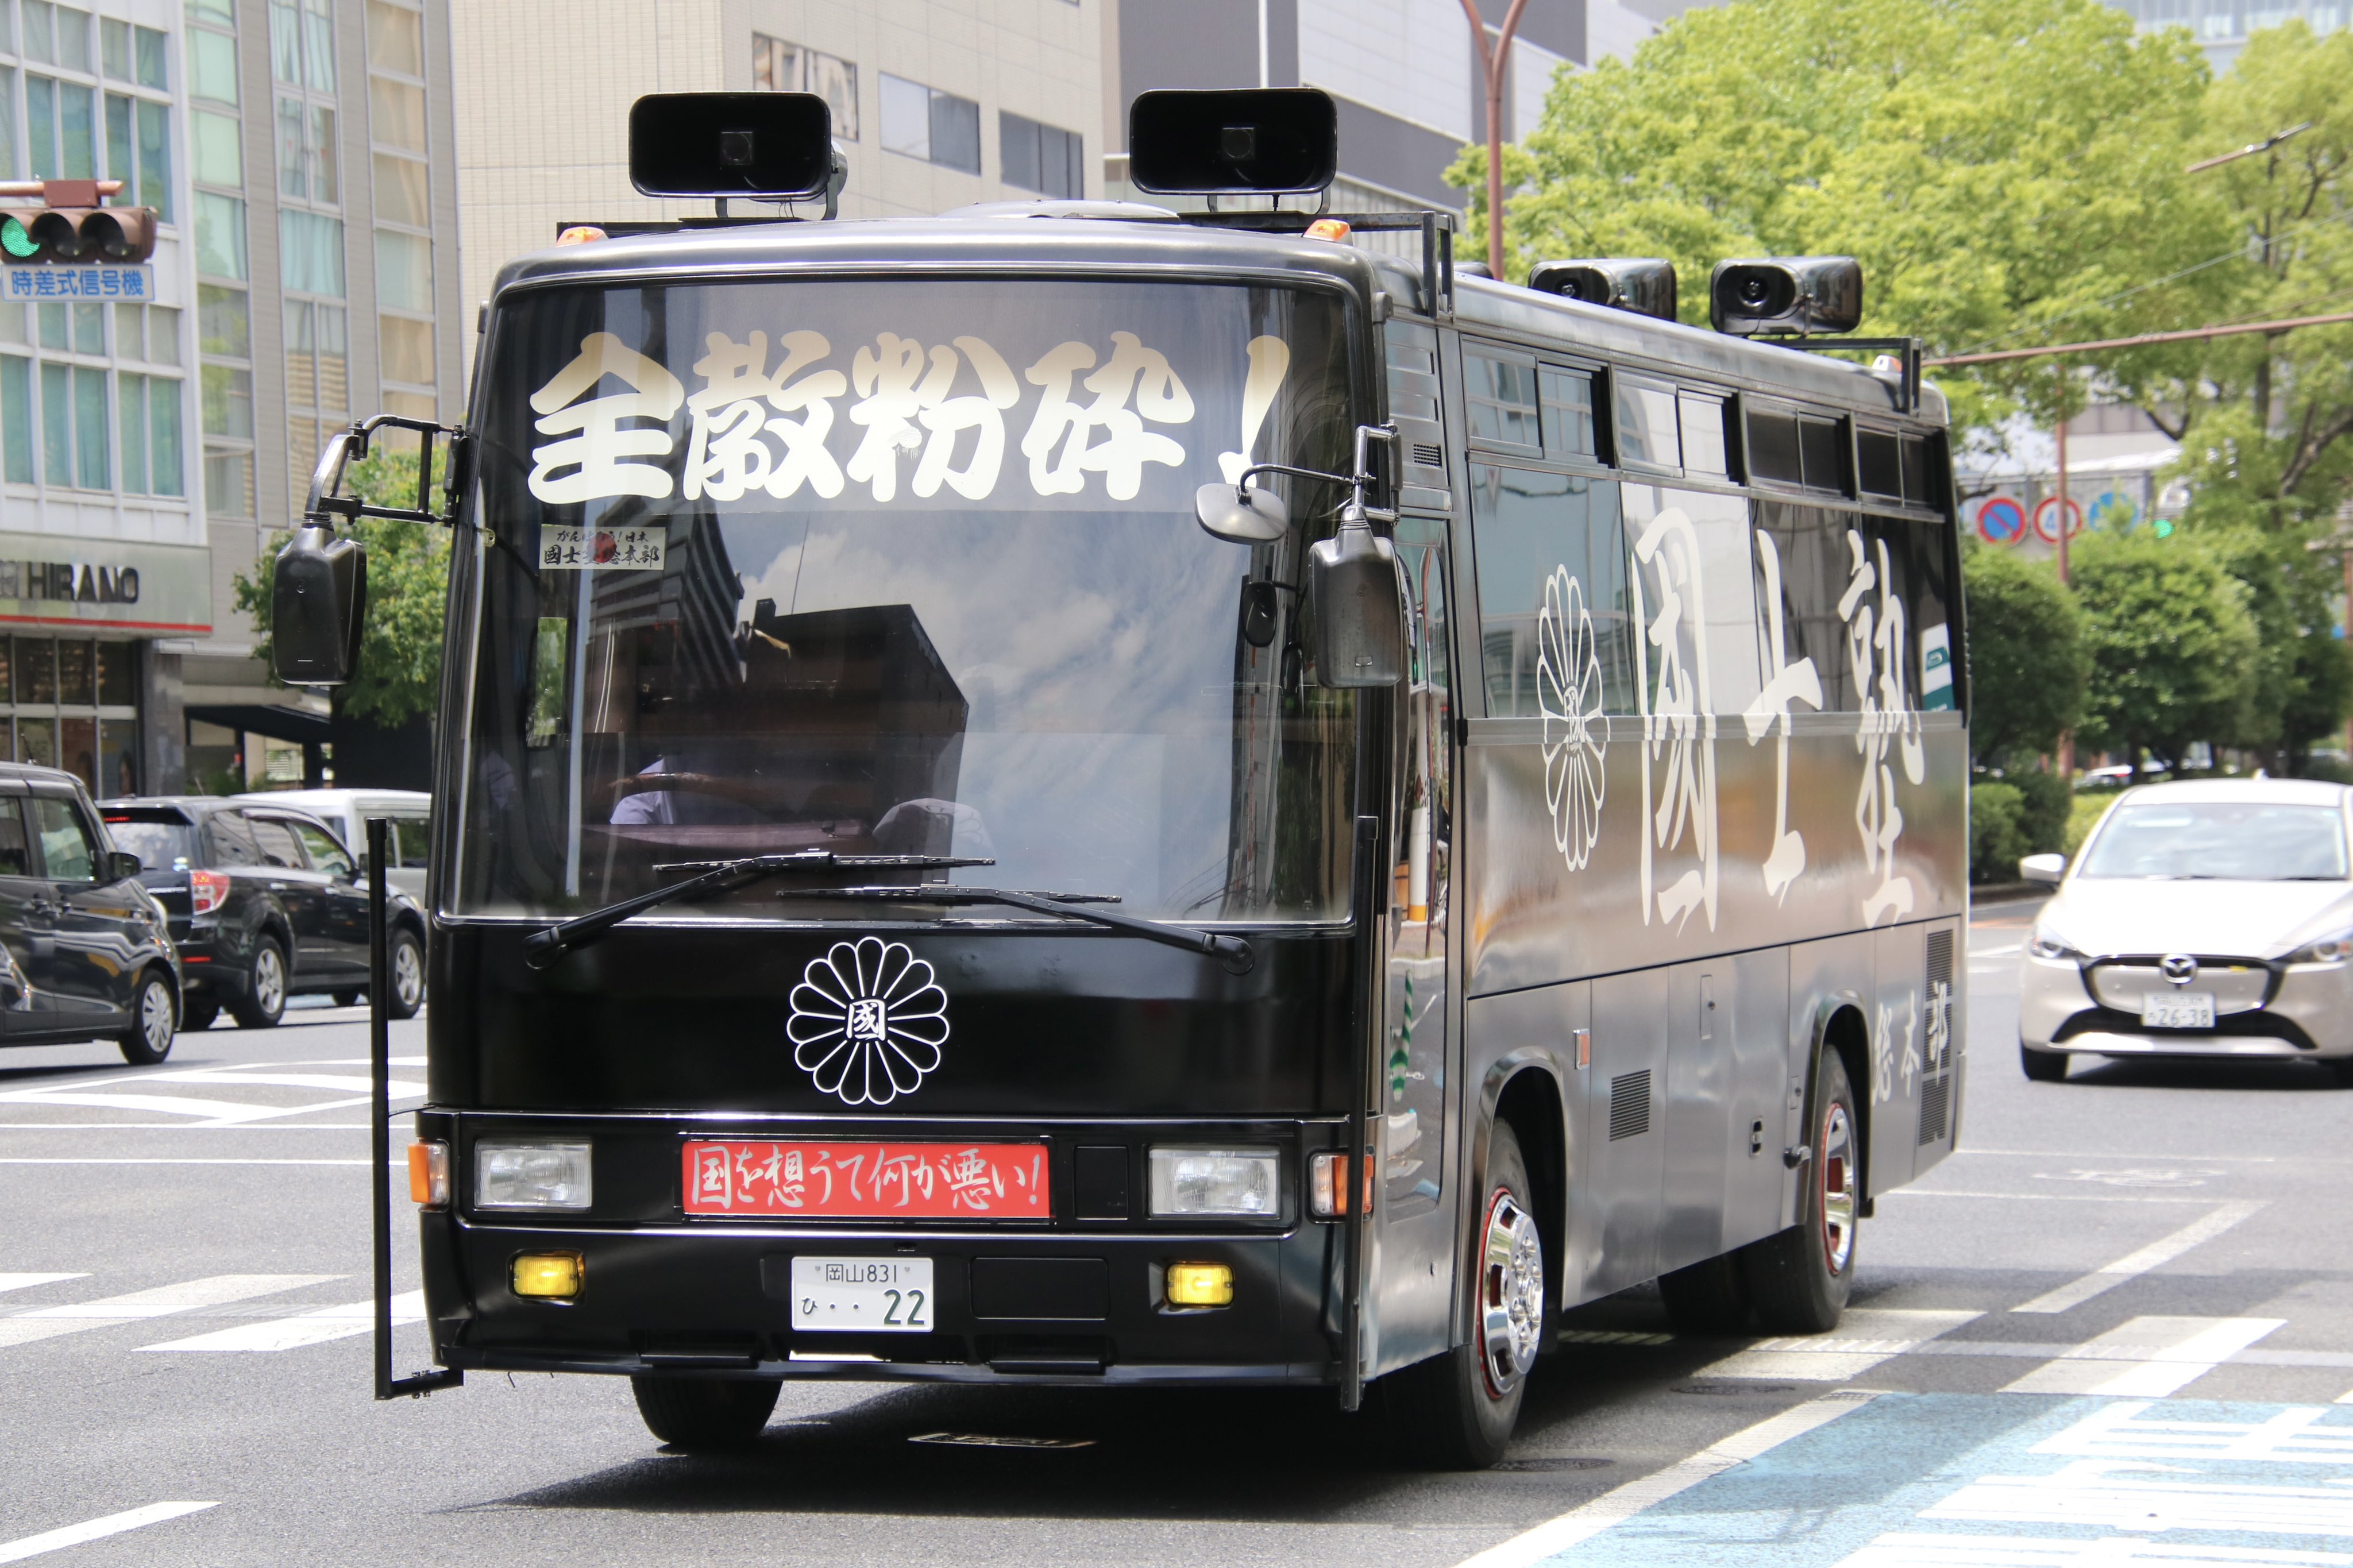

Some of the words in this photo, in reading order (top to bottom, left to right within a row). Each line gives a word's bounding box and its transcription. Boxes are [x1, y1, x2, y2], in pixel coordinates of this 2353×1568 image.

[11, 269, 144, 296] 時差式信号機
[557, 531, 649, 542] がんばう!日本
[543, 544, 659, 567] 國士本部
[28, 561, 140, 604] HIRANO
[801, 1297, 817, 1315] ひ
